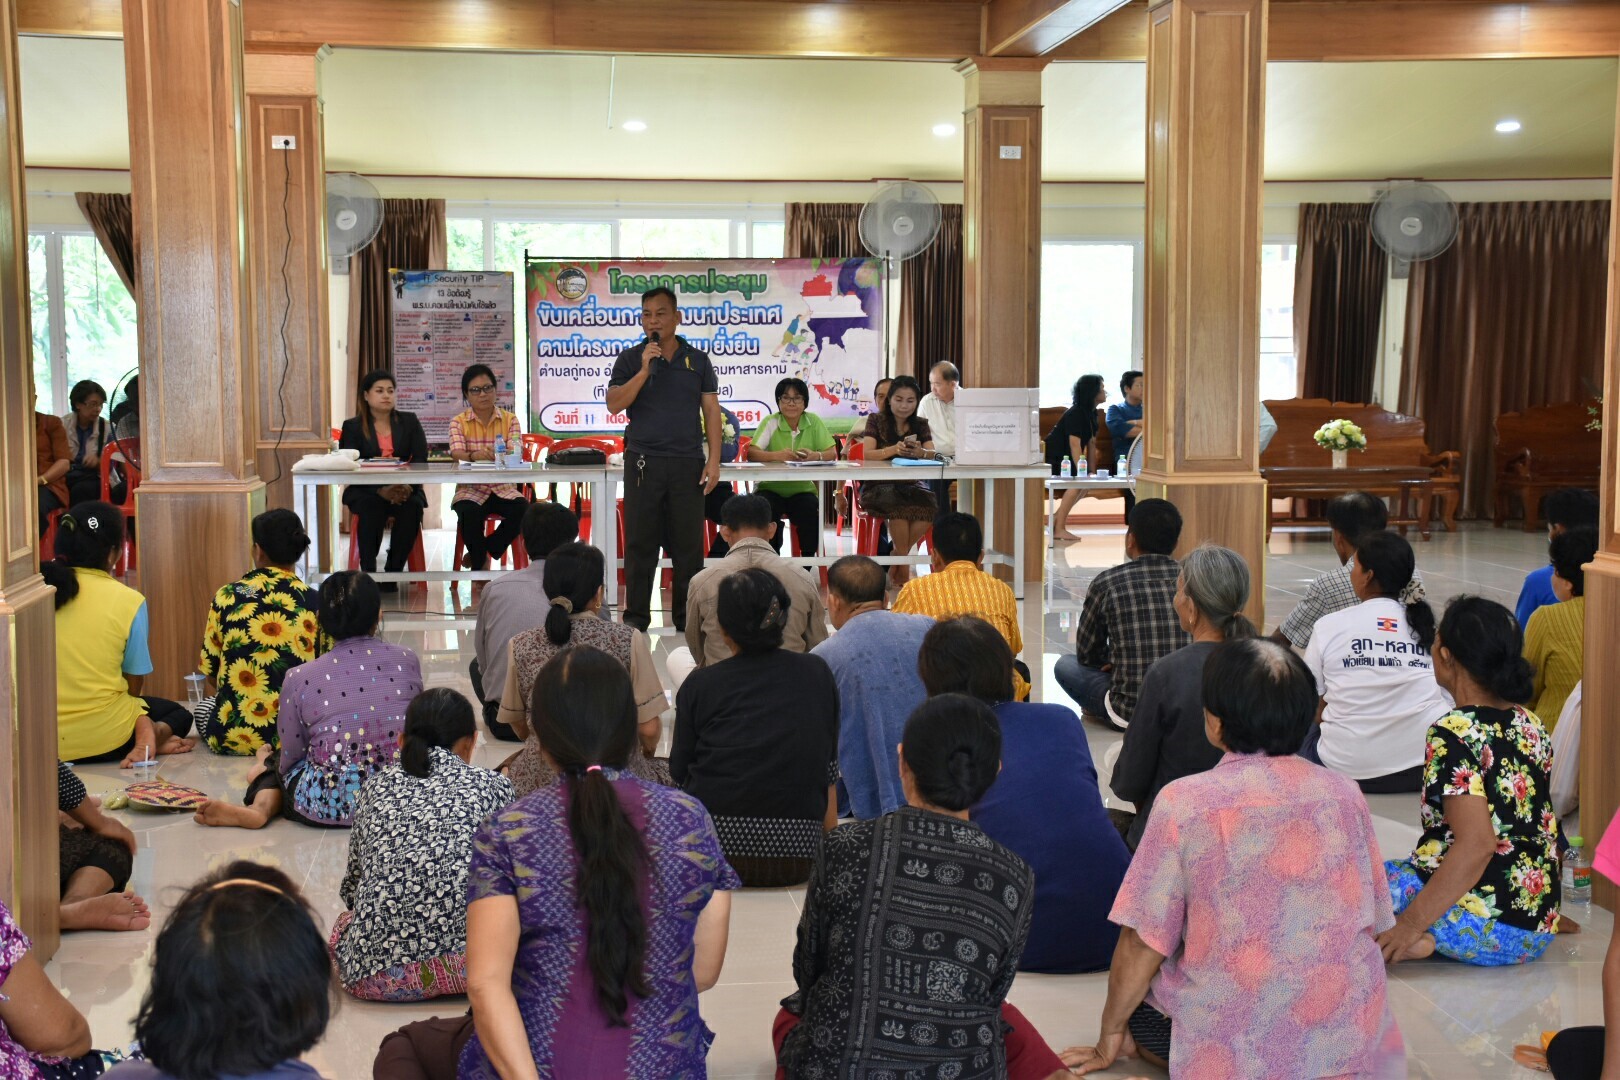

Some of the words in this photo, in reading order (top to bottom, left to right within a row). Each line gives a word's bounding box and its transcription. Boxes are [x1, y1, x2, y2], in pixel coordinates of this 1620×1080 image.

[434, 274, 468, 284] Security
[608, 268, 767, 300] โครงการประชุม
[437, 289, 445, 297] 13
[713, 327, 760, 356] ยั่งยืน
[540, 364, 600, 381] ตำบลกู่ทอง
[554, 408, 579, 425] วันที่
